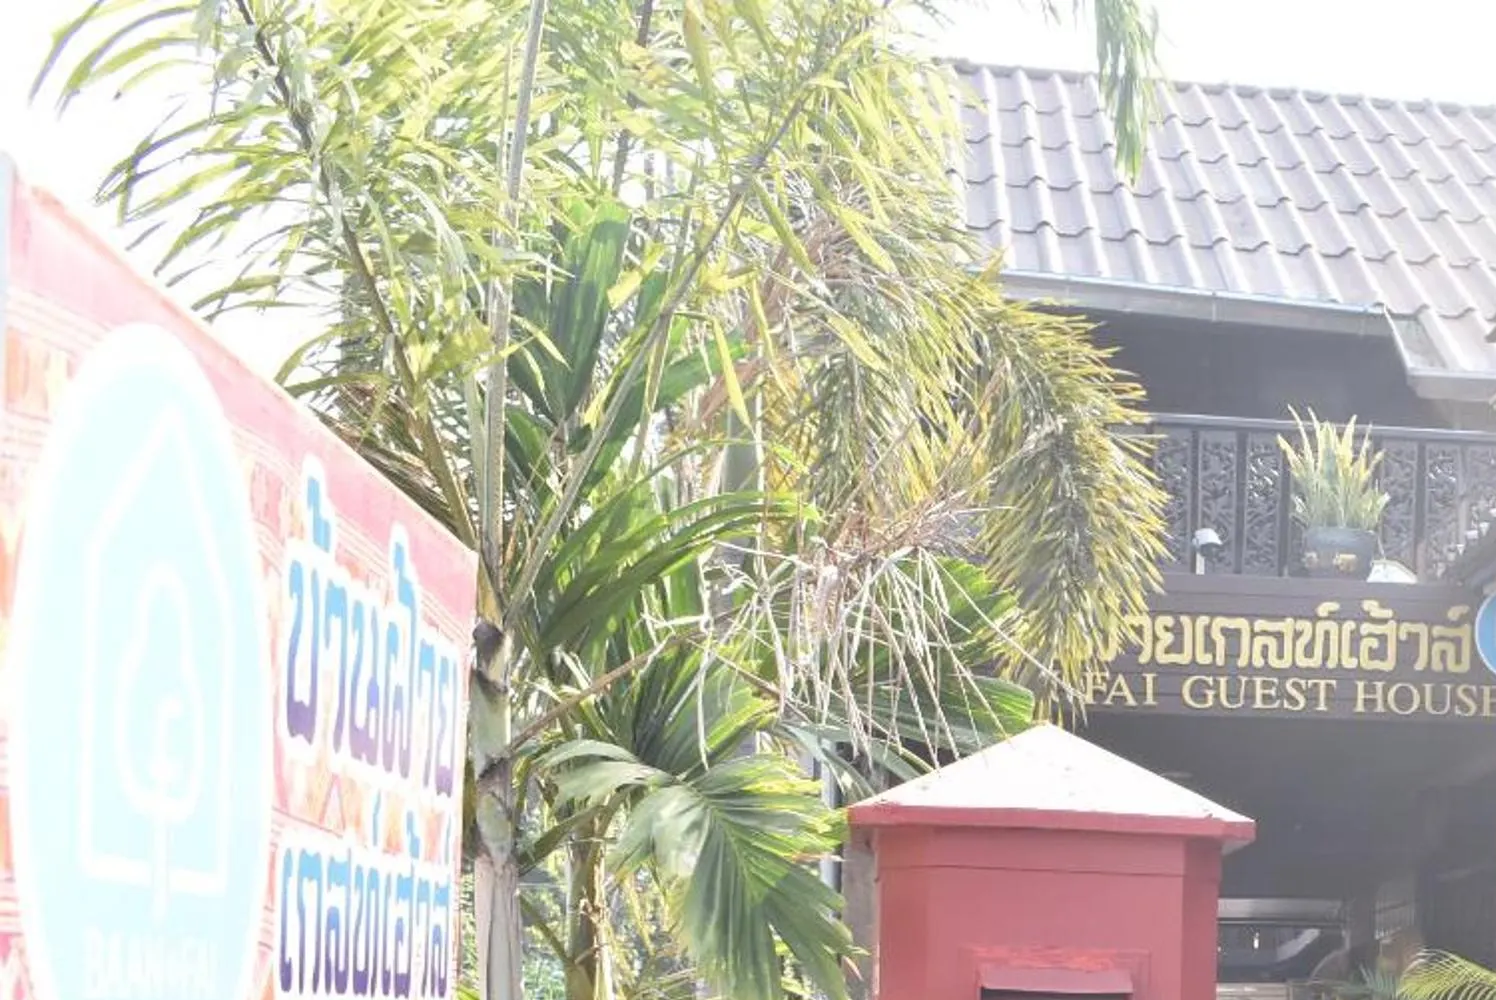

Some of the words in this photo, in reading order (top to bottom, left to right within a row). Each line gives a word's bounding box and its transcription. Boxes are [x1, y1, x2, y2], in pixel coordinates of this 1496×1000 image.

[285, 470, 459, 796] บ้านฝ้าย
[1181, 675, 1337, 713] GUEST
